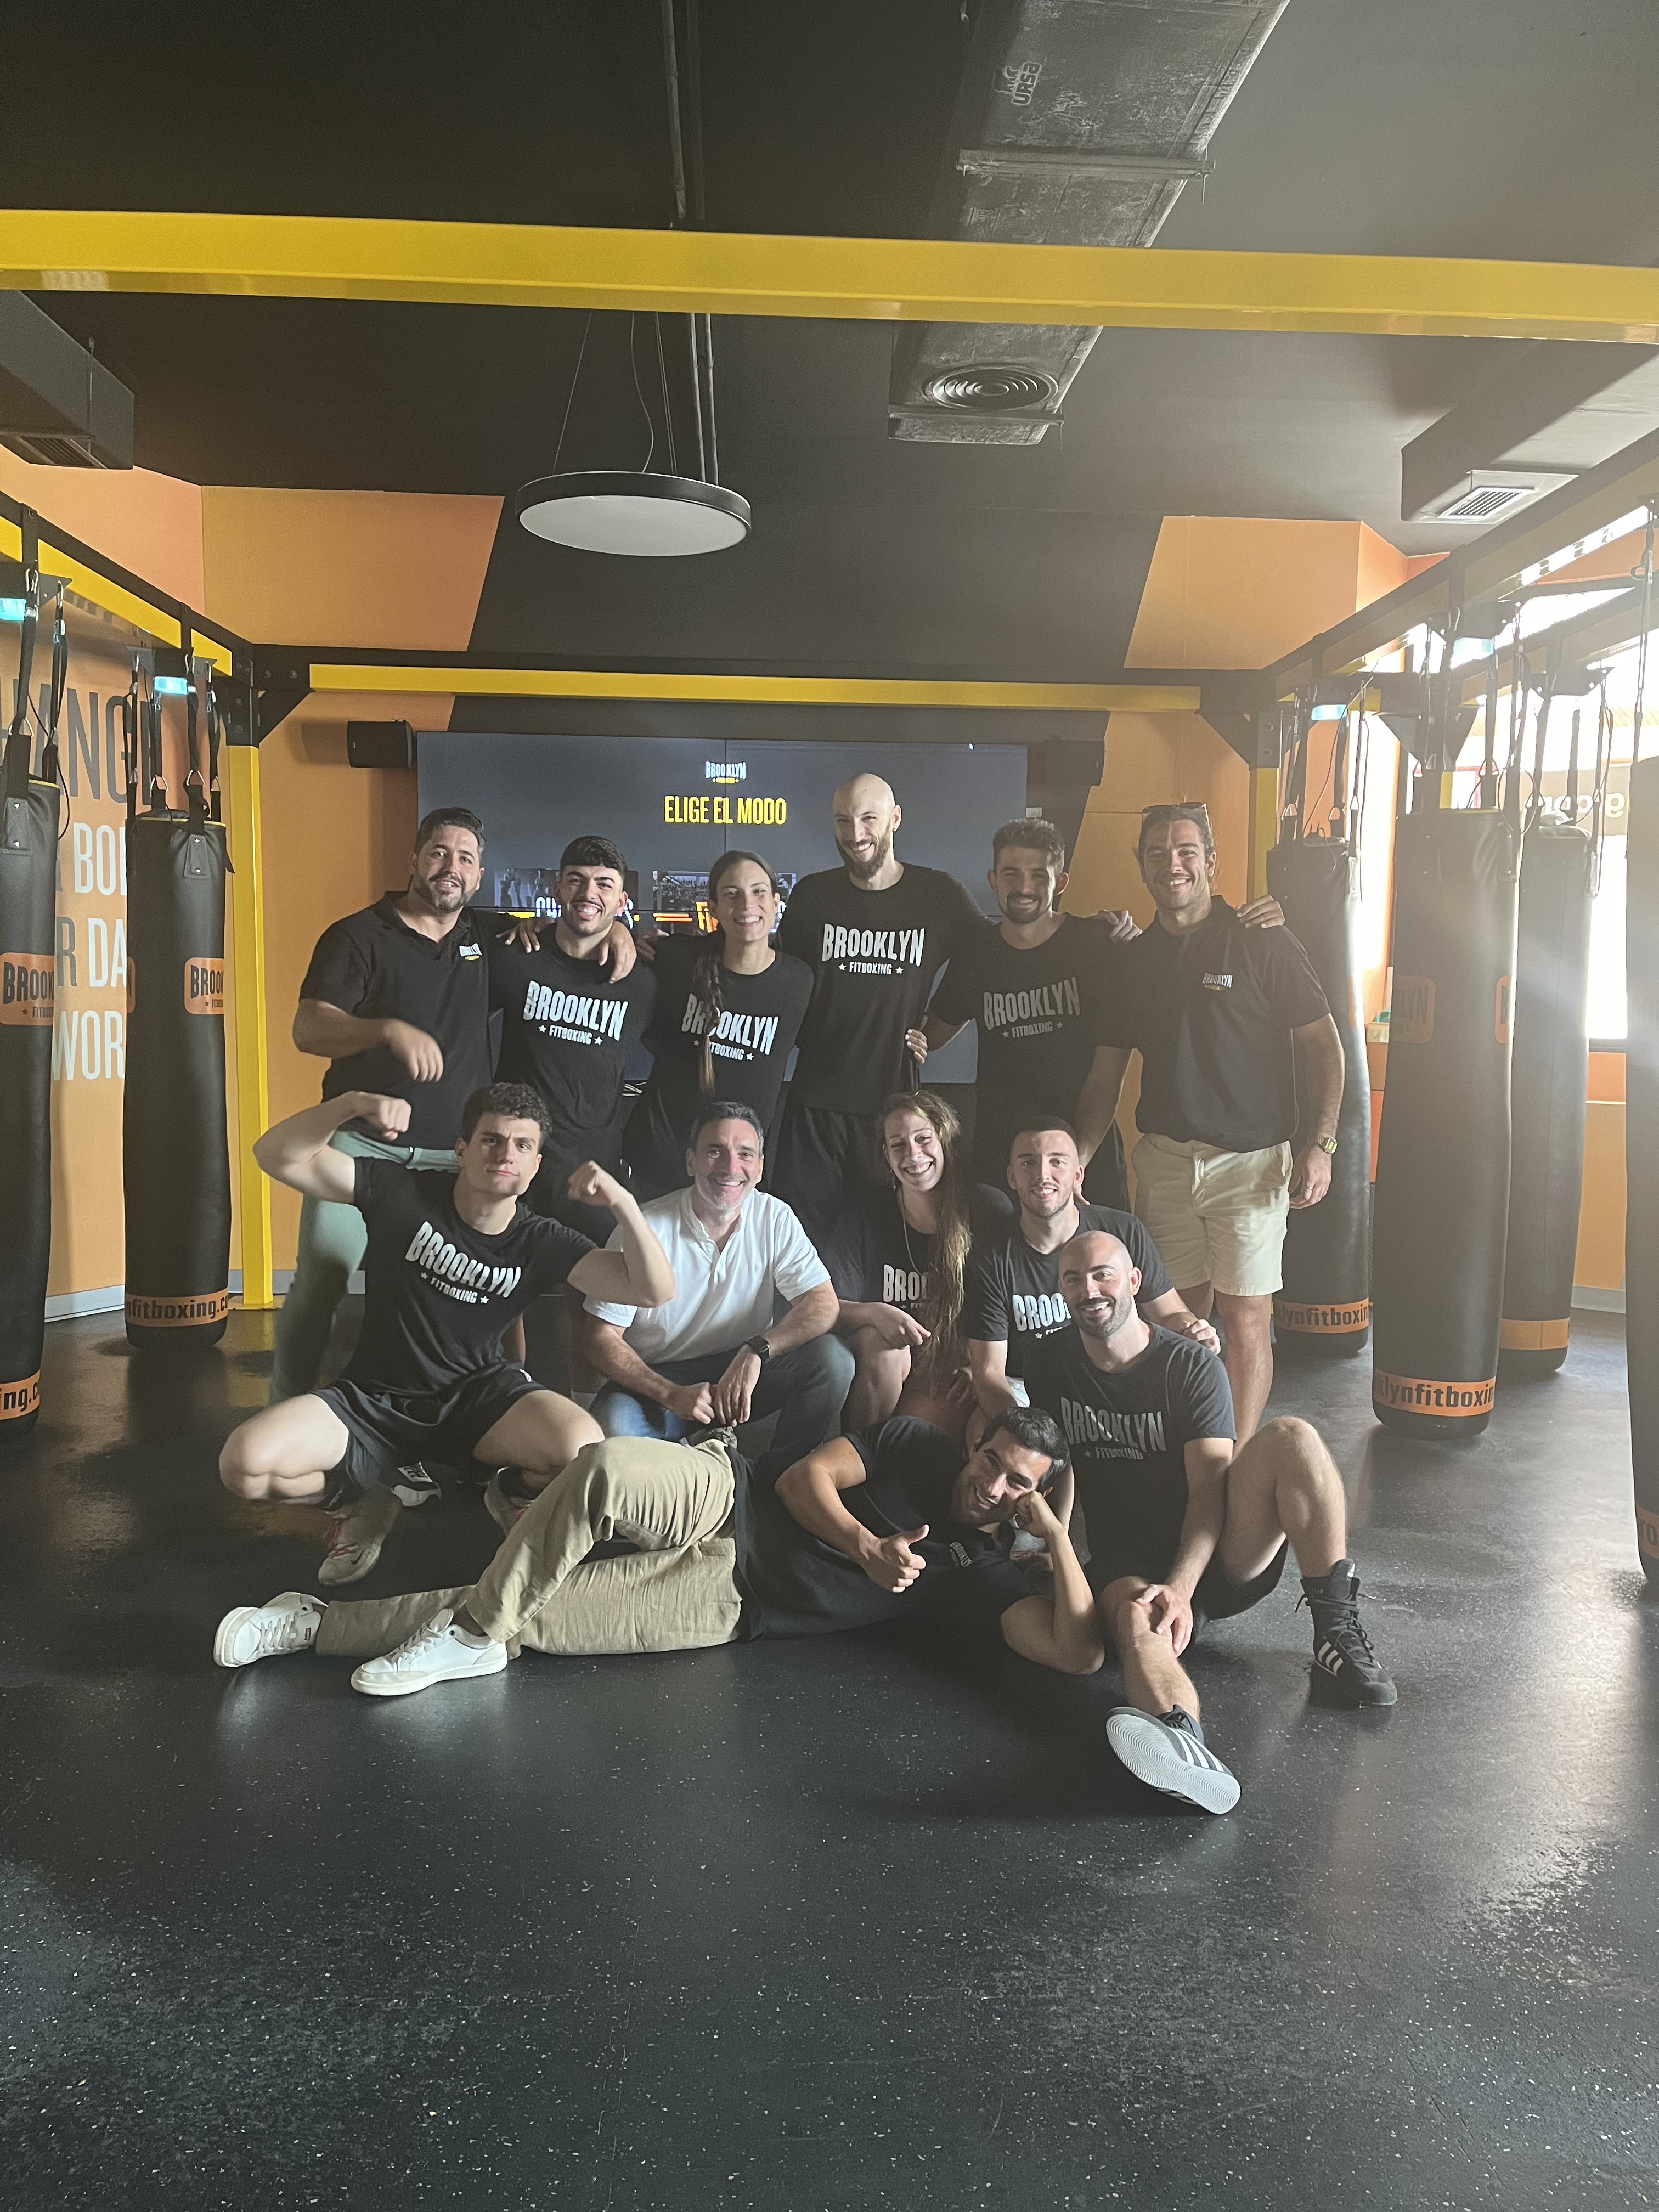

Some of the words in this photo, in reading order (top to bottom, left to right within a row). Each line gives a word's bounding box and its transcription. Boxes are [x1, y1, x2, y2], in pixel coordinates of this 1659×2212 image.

[706, 760, 747, 780] BROOKLYN
[664, 795, 710, 823] ELIGE
[713, 797, 734, 823] EL
[737, 797, 786, 825] MODO
[822, 923, 925, 973] BROOKLYN
[849, 962, 893, 975] FITBOXING
[1203, 972, 1233, 988] BROOKLYN
[523, 980, 628, 1041] BROOKLYN
[984, 977, 1080, 1030] BROOKLYN
[549, 1025, 592, 1045] FITBOXING
[1012, 1021, 1053, 1039] FITBOXING
[405, 1221, 521, 1299] BROOKLYN
[431, 1277, 478, 1304] FITBOXING
[1060, 1397, 1167, 1453] BROOKLYN
[1094, 1447, 1143, 1460] FITBOXING
